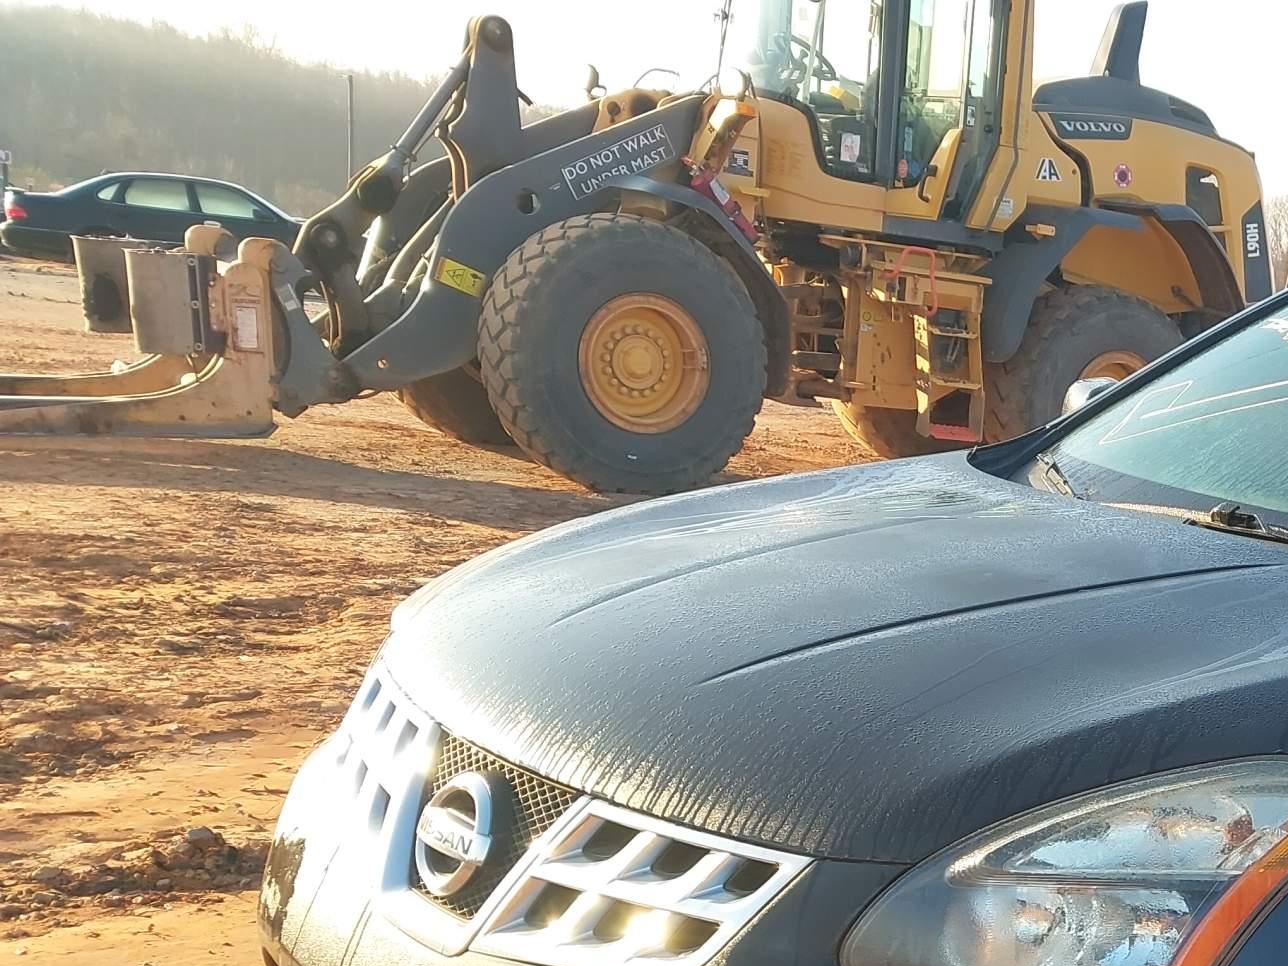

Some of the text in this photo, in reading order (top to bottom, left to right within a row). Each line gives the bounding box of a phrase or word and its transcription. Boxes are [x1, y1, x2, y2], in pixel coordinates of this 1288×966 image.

[1060, 120, 1126, 133] VOLVO
[564, 127, 665, 180] DO NOT WALK
[631, 146, 666, 172] MAST
[1247, 223, 1260, 257] L90H
